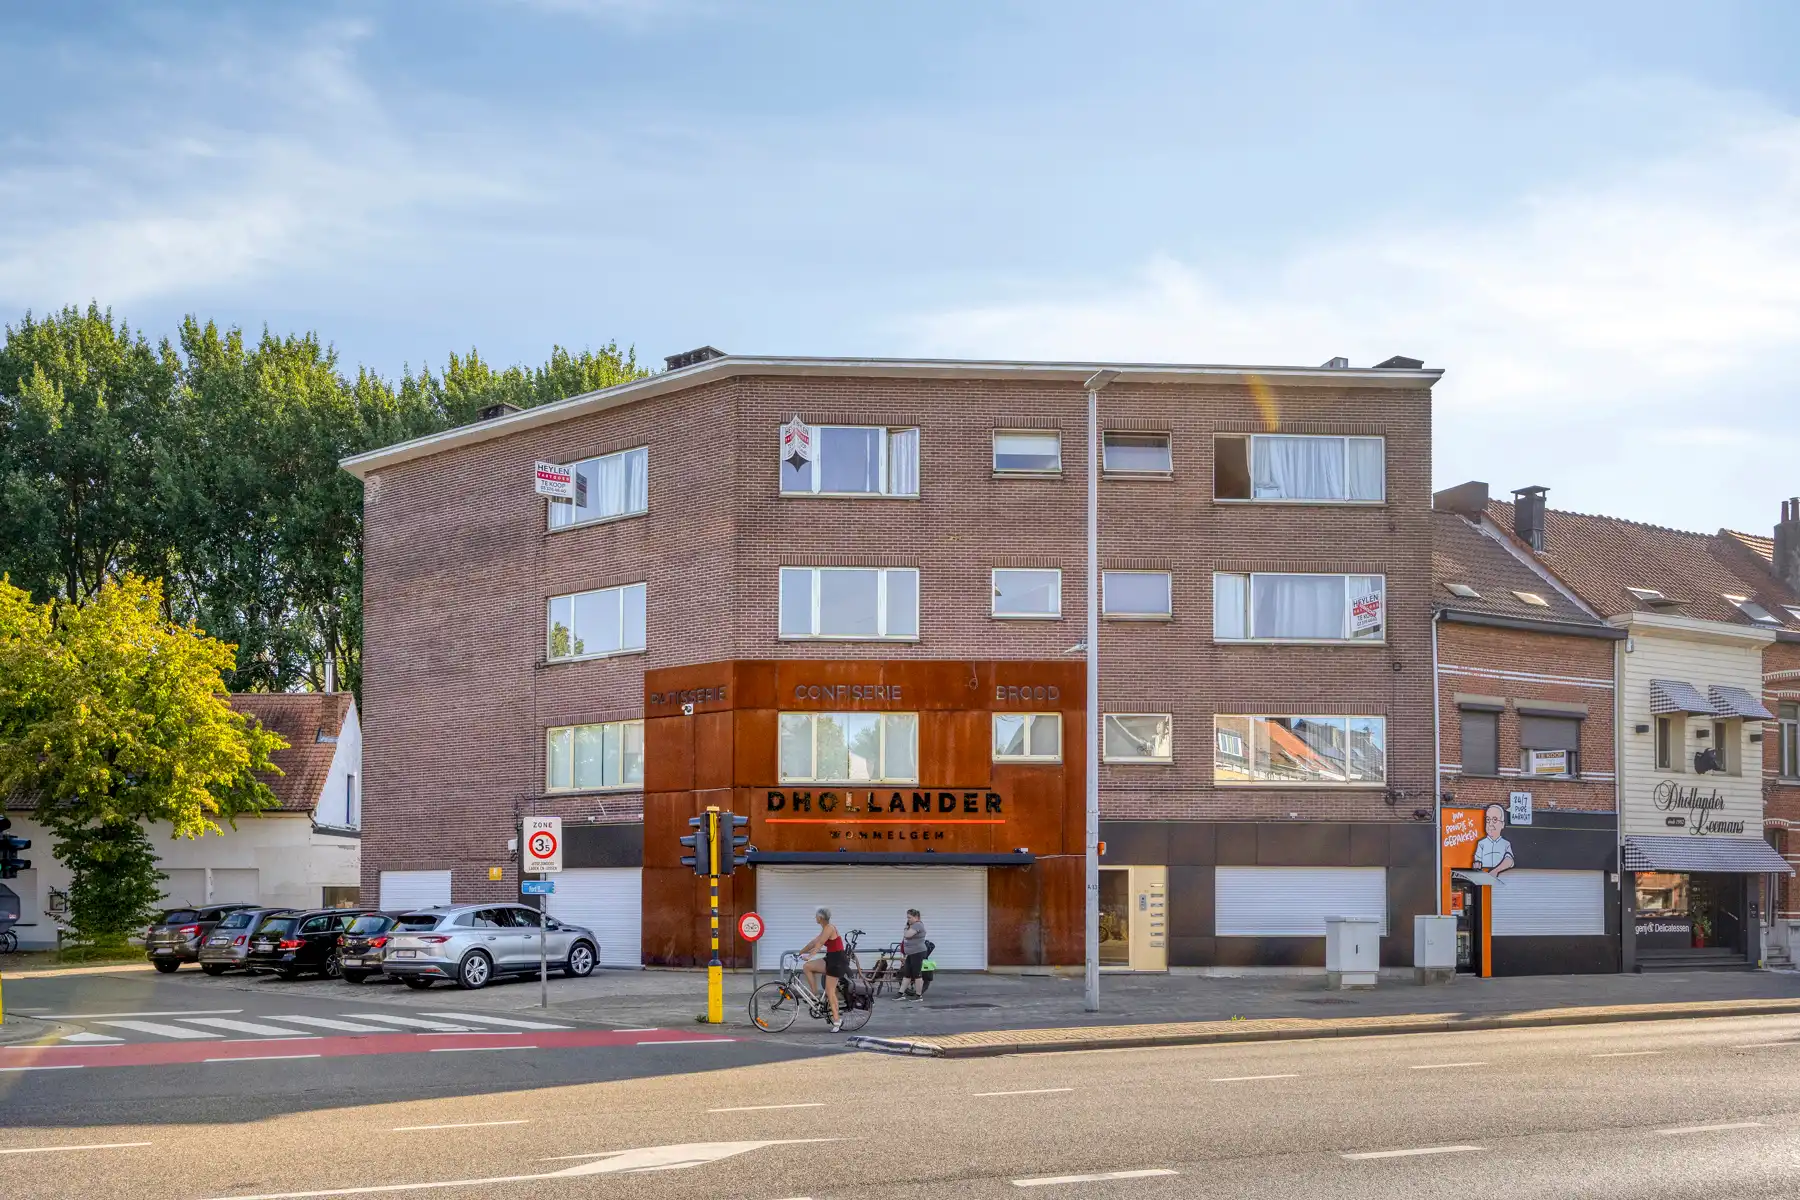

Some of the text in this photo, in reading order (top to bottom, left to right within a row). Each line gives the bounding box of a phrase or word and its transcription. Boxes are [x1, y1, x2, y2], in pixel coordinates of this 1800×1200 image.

[538, 464, 570, 475] HEYLEN
[538, 472, 570, 481] VASTGOED
[1354, 594, 1378, 607] HEYLEN
[650, 685, 727, 706] PATISSERIE
[795, 684, 903, 701] CONFISERIE
[995, 685, 1060, 701] BROOD
[767, 791, 1003, 813] DHOLLANDER
[1513, 794, 1528, 808] 24/7
[1654, 780, 1725, 811] Dhollander
[1690, 807, 1744, 835] Leemans
[830, 830, 945, 840] WOMMELGEM
[1444, 829, 1478, 847] GEBAKKEN
[1654, 923, 1690, 933] Delicatessen
